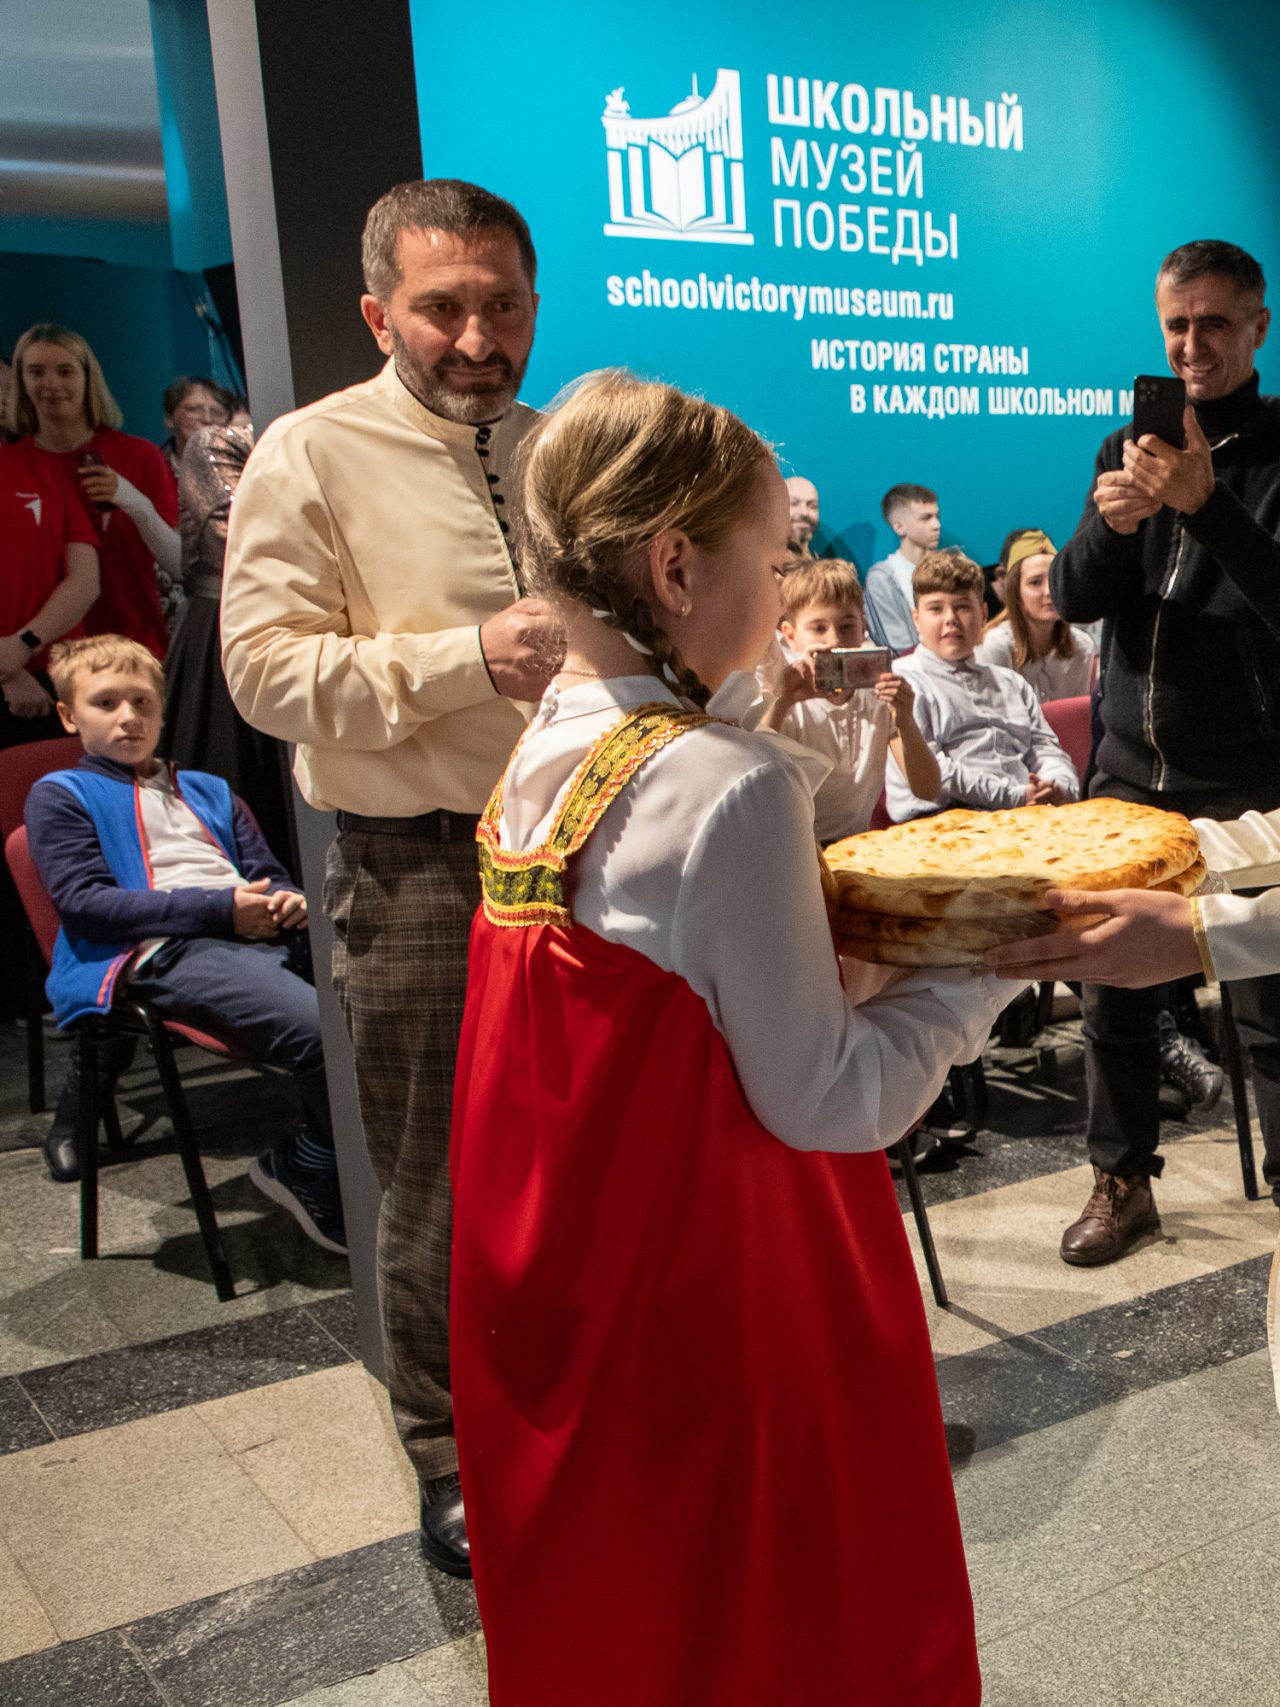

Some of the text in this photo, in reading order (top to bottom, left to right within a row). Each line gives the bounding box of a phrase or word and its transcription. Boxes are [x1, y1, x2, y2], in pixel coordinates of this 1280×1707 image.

[767, 74, 1024, 151] ШКОЛЬНЫЙ
[771, 137, 923, 198] МУЗЕЙ
[774, 199, 957, 265] ПОБЕДЫ
[607, 270, 953, 320] schoolvictorymuseum.ru
[811, 338, 1028, 375] ИСТОРИЯ СТРАНЫ
[850, 384, 866, 414] В
[873, 384, 979, 419] КАЖДОМ
[988, 386, 1113, 416] ШКОЛЬНОМ
